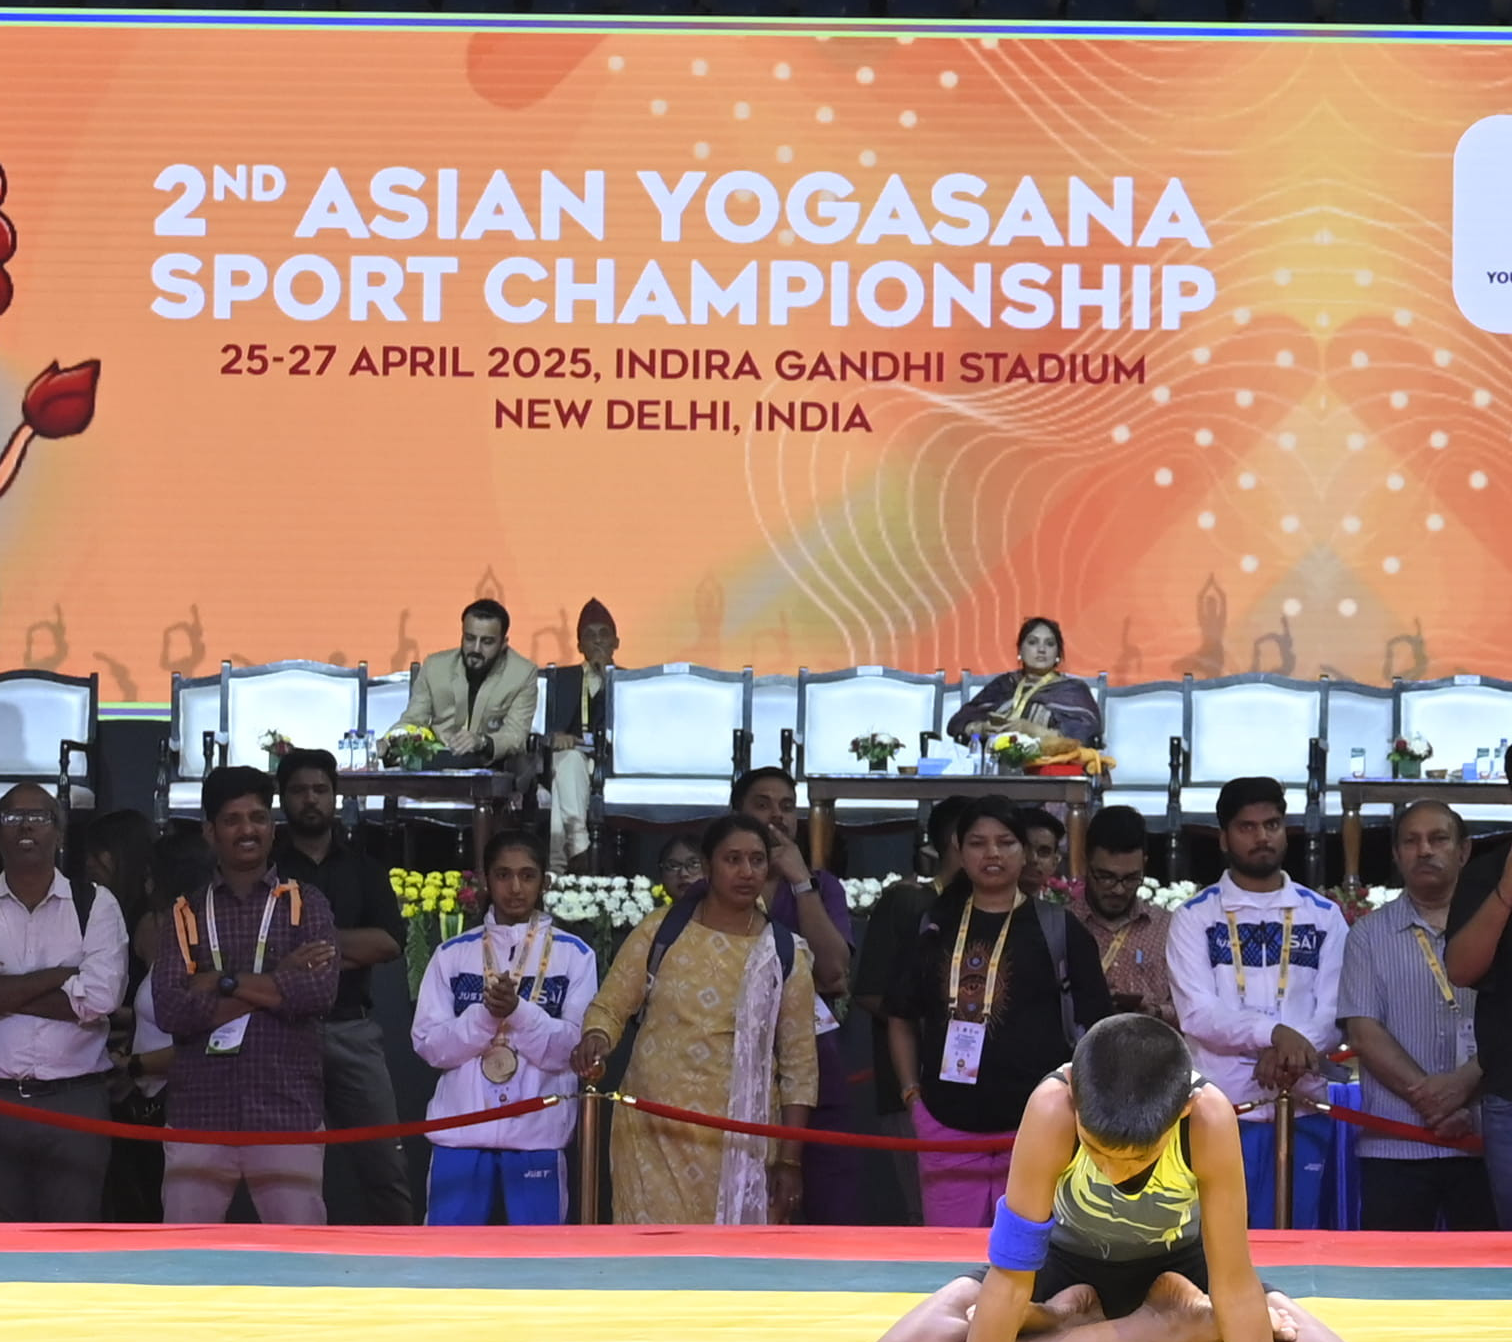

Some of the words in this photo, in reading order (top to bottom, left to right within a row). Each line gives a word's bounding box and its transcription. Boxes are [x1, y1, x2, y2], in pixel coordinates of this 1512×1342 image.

[152, 162, 286, 237] 2ND
[293, 166, 605, 240] ASIAN
[636, 170, 1212, 249] YOGASANA
[150, 252, 458, 321] SPORT
[483, 257, 1216, 331] CHAMPIONSHIP
[219, 343, 337, 377] 25-27
[349, 346, 474, 379] APRIL
[487, 346, 603, 385] 2025,
[614, 347, 762, 382] INDIRA
[774, 349, 946, 384] GANDHI
[958, 350, 1147, 387] STADIUM
[494, 398, 595, 432] NEW
[606, 399, 741, 438] DELHI,
[753, 399, 873, 434] INDIA
[1290, 935, 1316, 949] SAI
